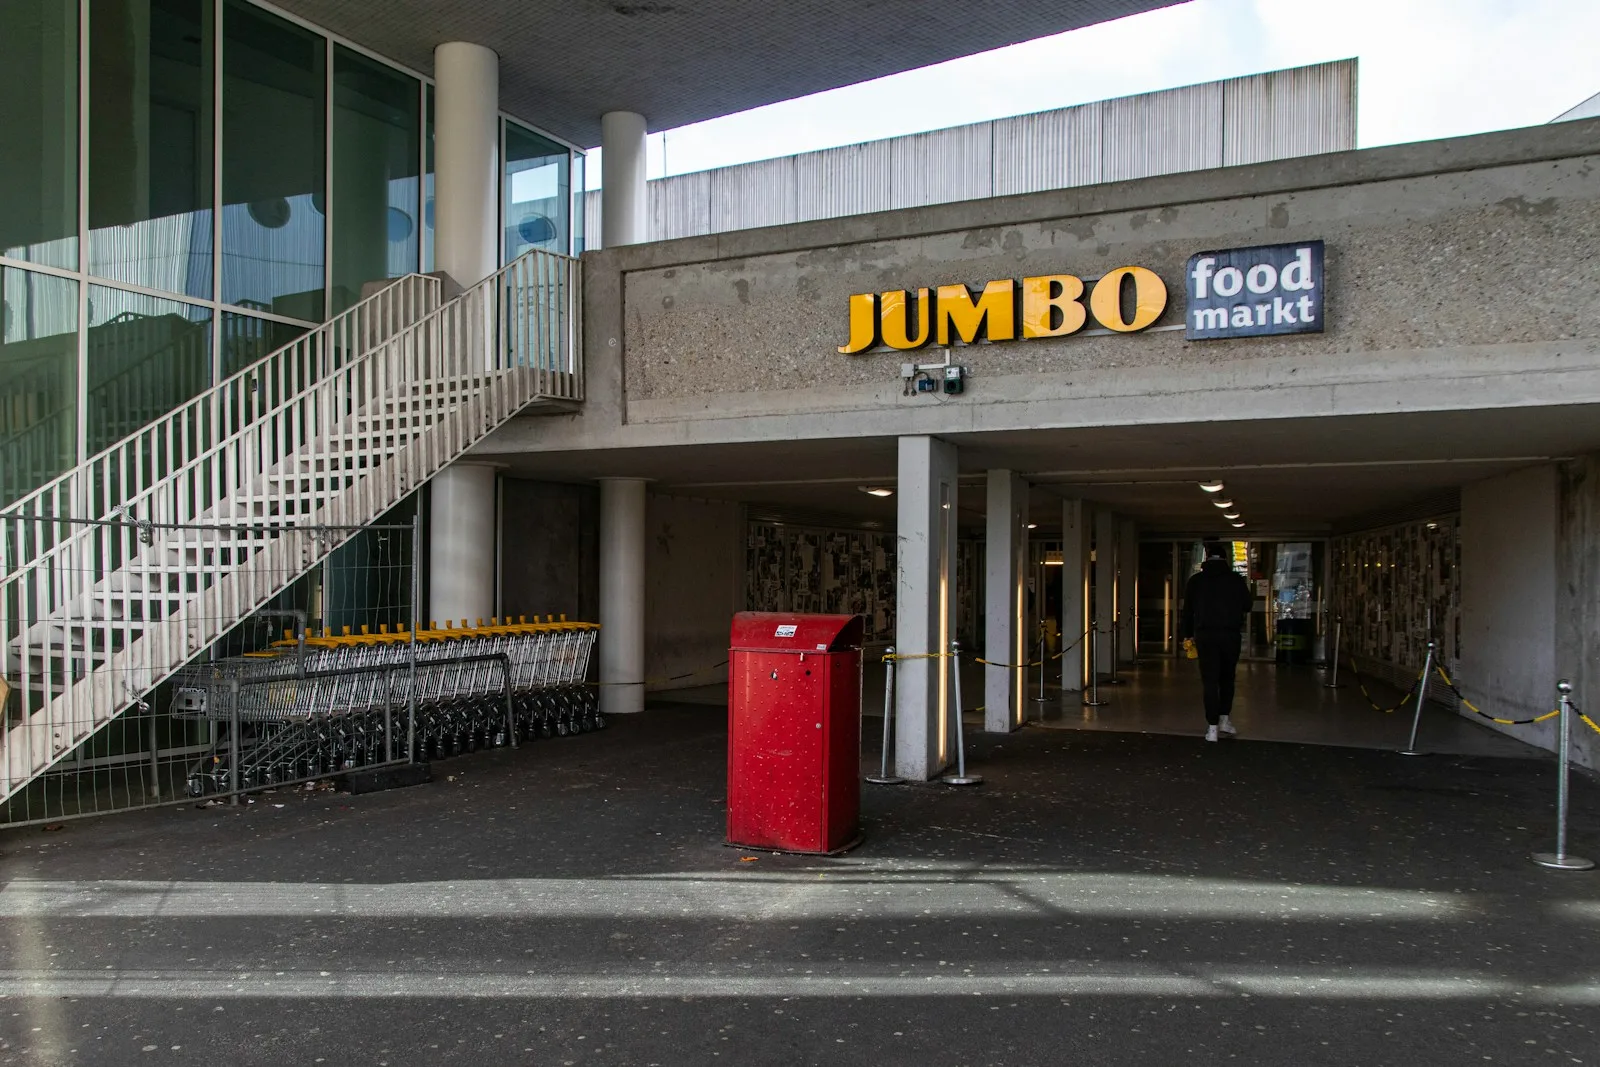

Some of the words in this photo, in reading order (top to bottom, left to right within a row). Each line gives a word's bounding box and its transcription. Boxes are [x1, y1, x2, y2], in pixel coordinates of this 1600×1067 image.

[1191, 248, 1315, 299] food
[838, 266, 1167, 354] JUMBO
[1193, 295, 1315, 330] markt
